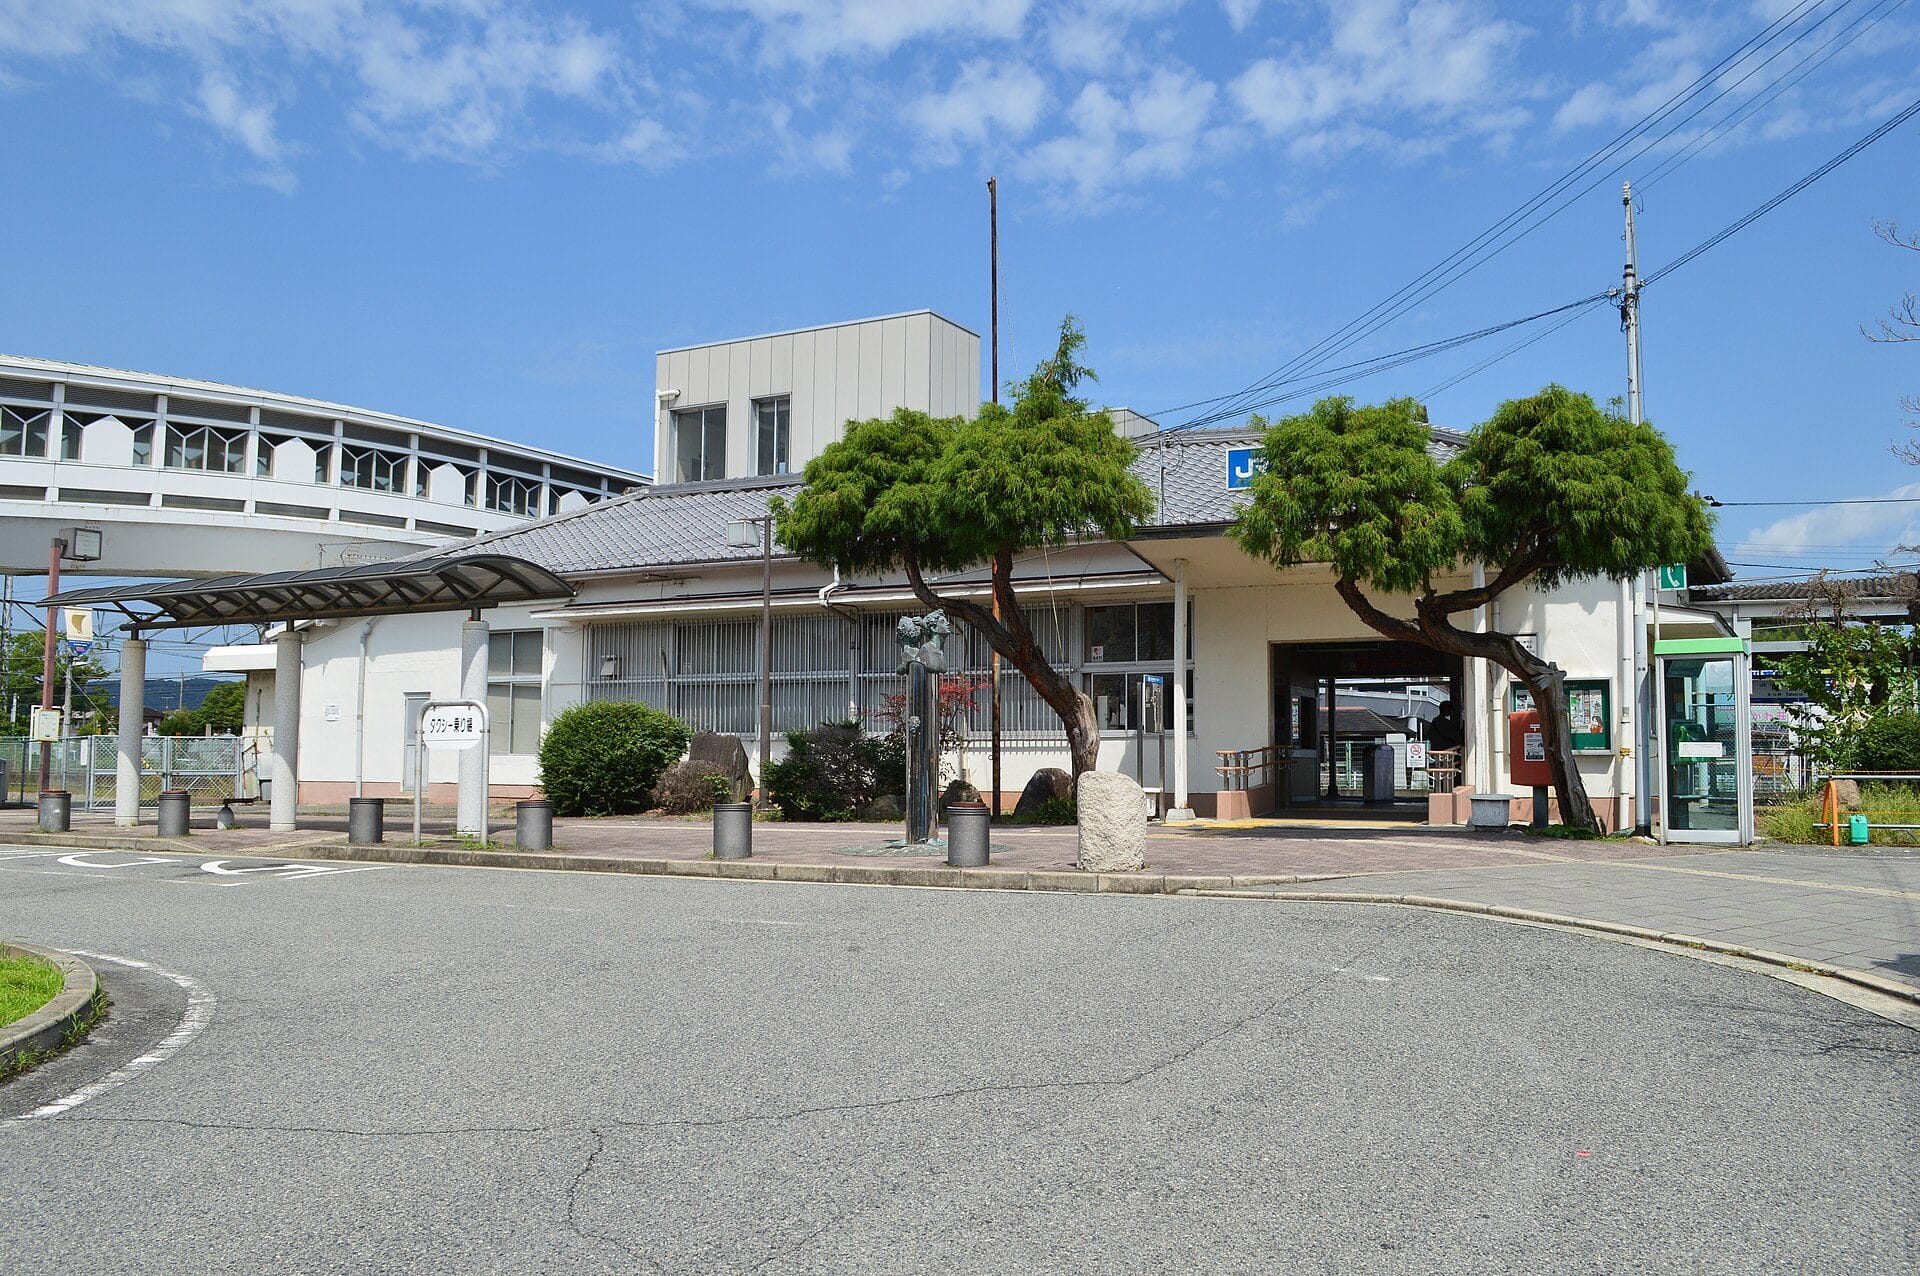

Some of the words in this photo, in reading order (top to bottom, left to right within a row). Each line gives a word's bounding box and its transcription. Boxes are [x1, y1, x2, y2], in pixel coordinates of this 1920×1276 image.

[430, 717, 473, 733] タクシー乗り場
